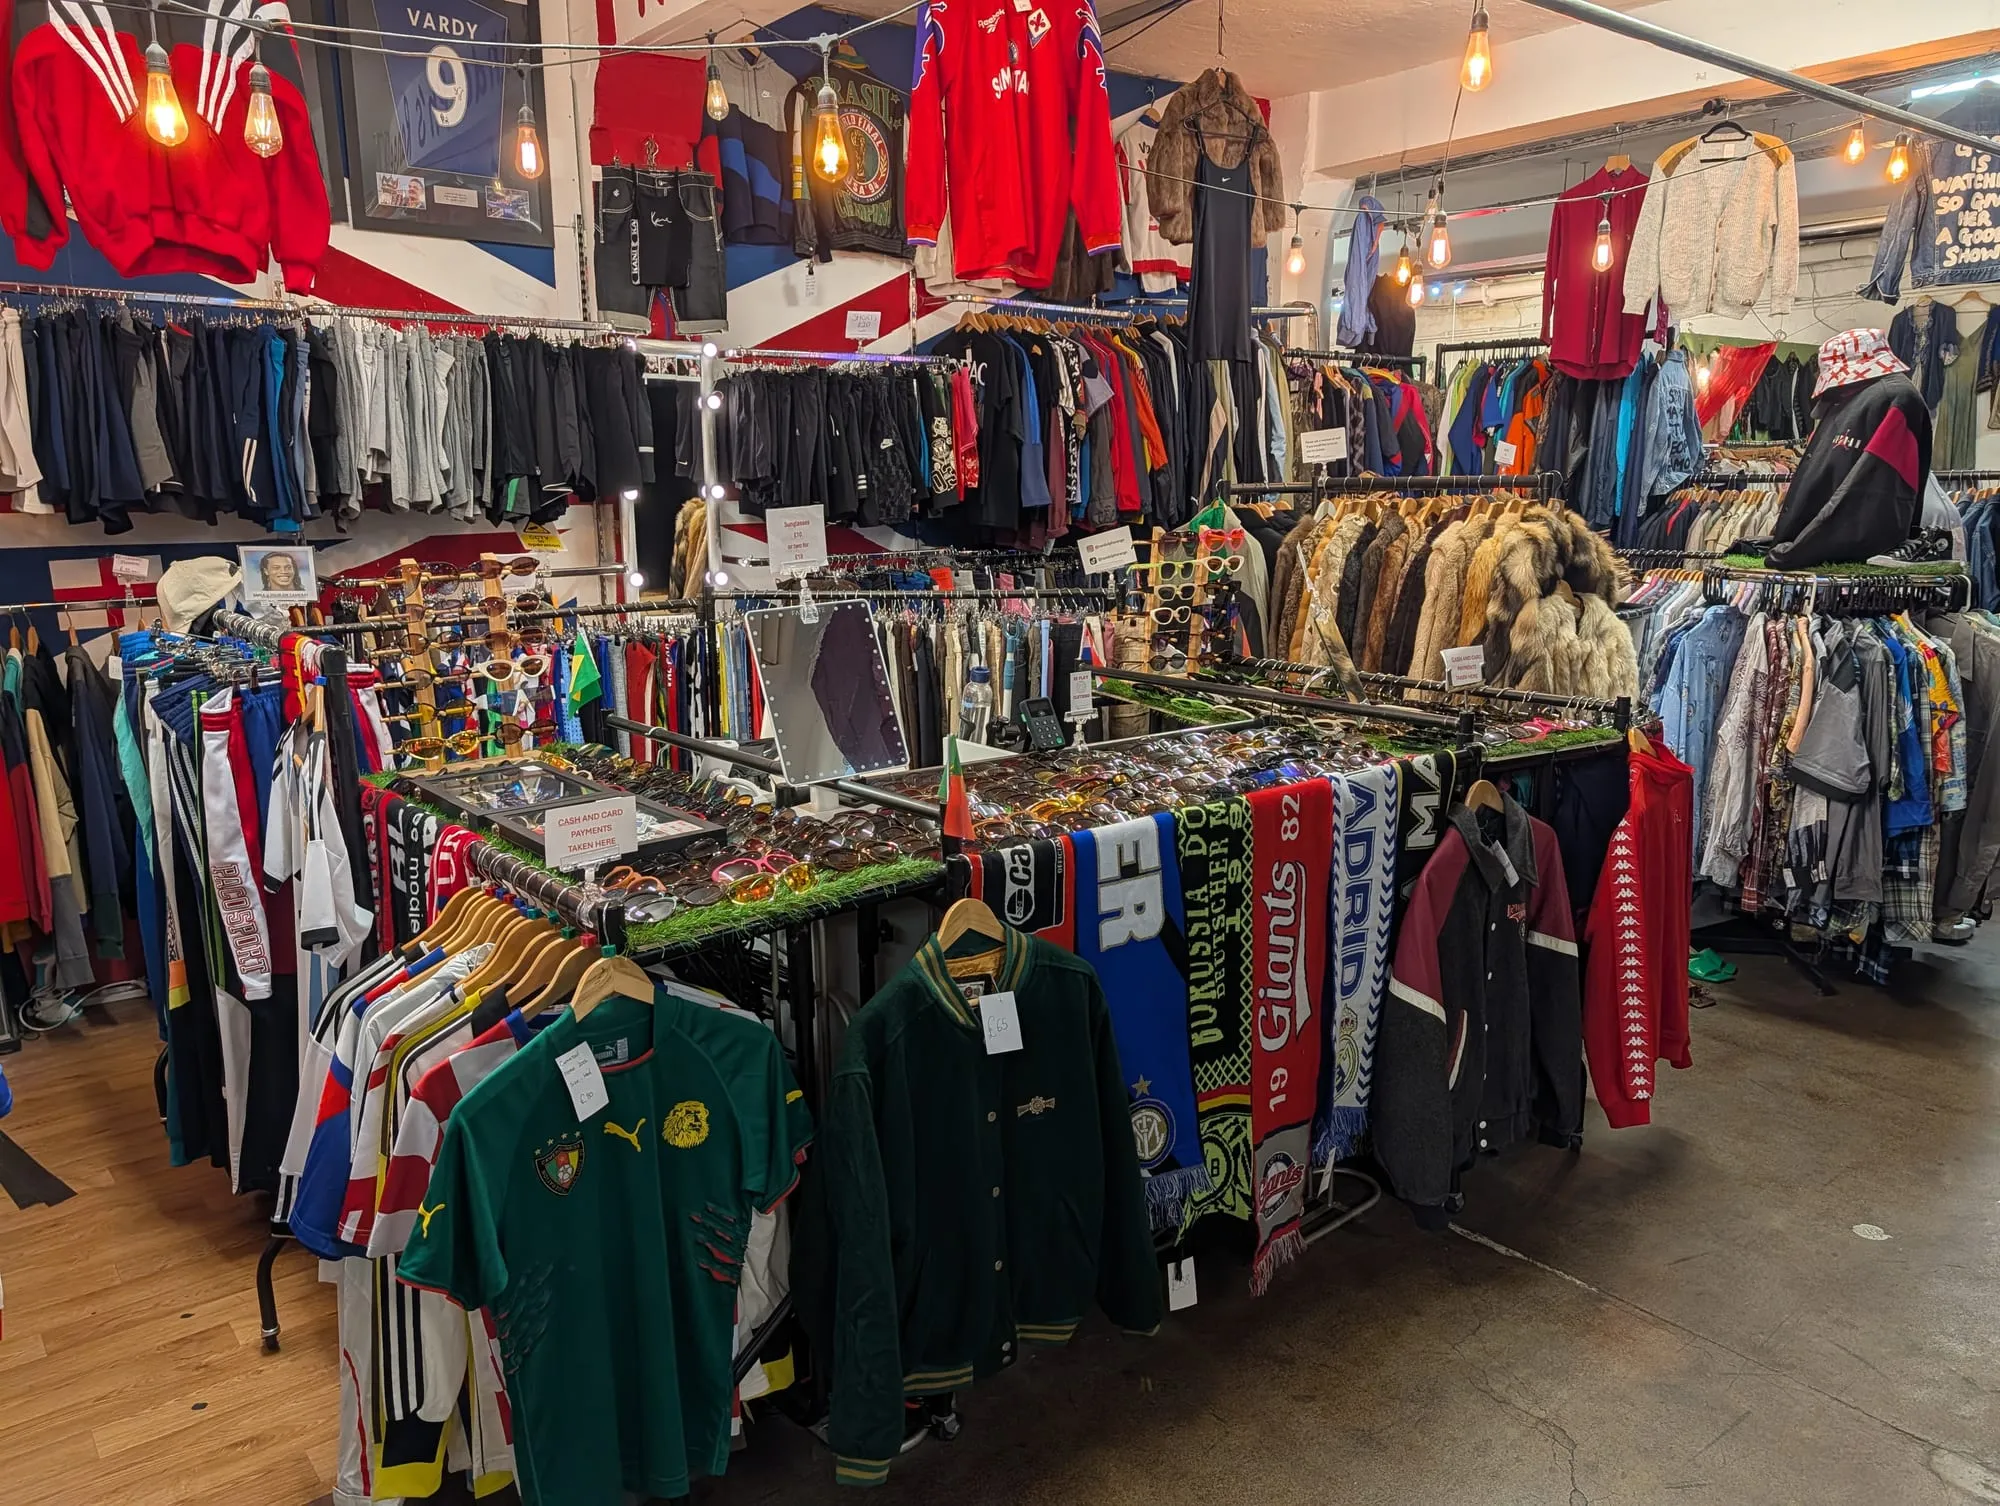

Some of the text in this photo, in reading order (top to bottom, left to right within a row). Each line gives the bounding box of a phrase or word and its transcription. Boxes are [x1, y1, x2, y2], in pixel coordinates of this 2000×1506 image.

[406, 7, 478, 40] VARDY
[426, 45, 468, 128] 9
[1971, 155, 1991, 173] IS
[1935, 196, 1964, 215] SO
[1957, 209, 1992, 228] HER
[1935, 226, 1953, 246] A
[558, 808, 624, 828] CASH AND CARD
[570, 824, 613, 839] PAYMENTS
[568, 837, 616, 853] TAKEN HERE
[211, 862, 271, 975] PACOSPORT
[1208, 837, 1229, 1000] DEUTSCHER
[1258, 860, 1302, 1053] Giants
[987, 1015, 1009, 1038] £65
